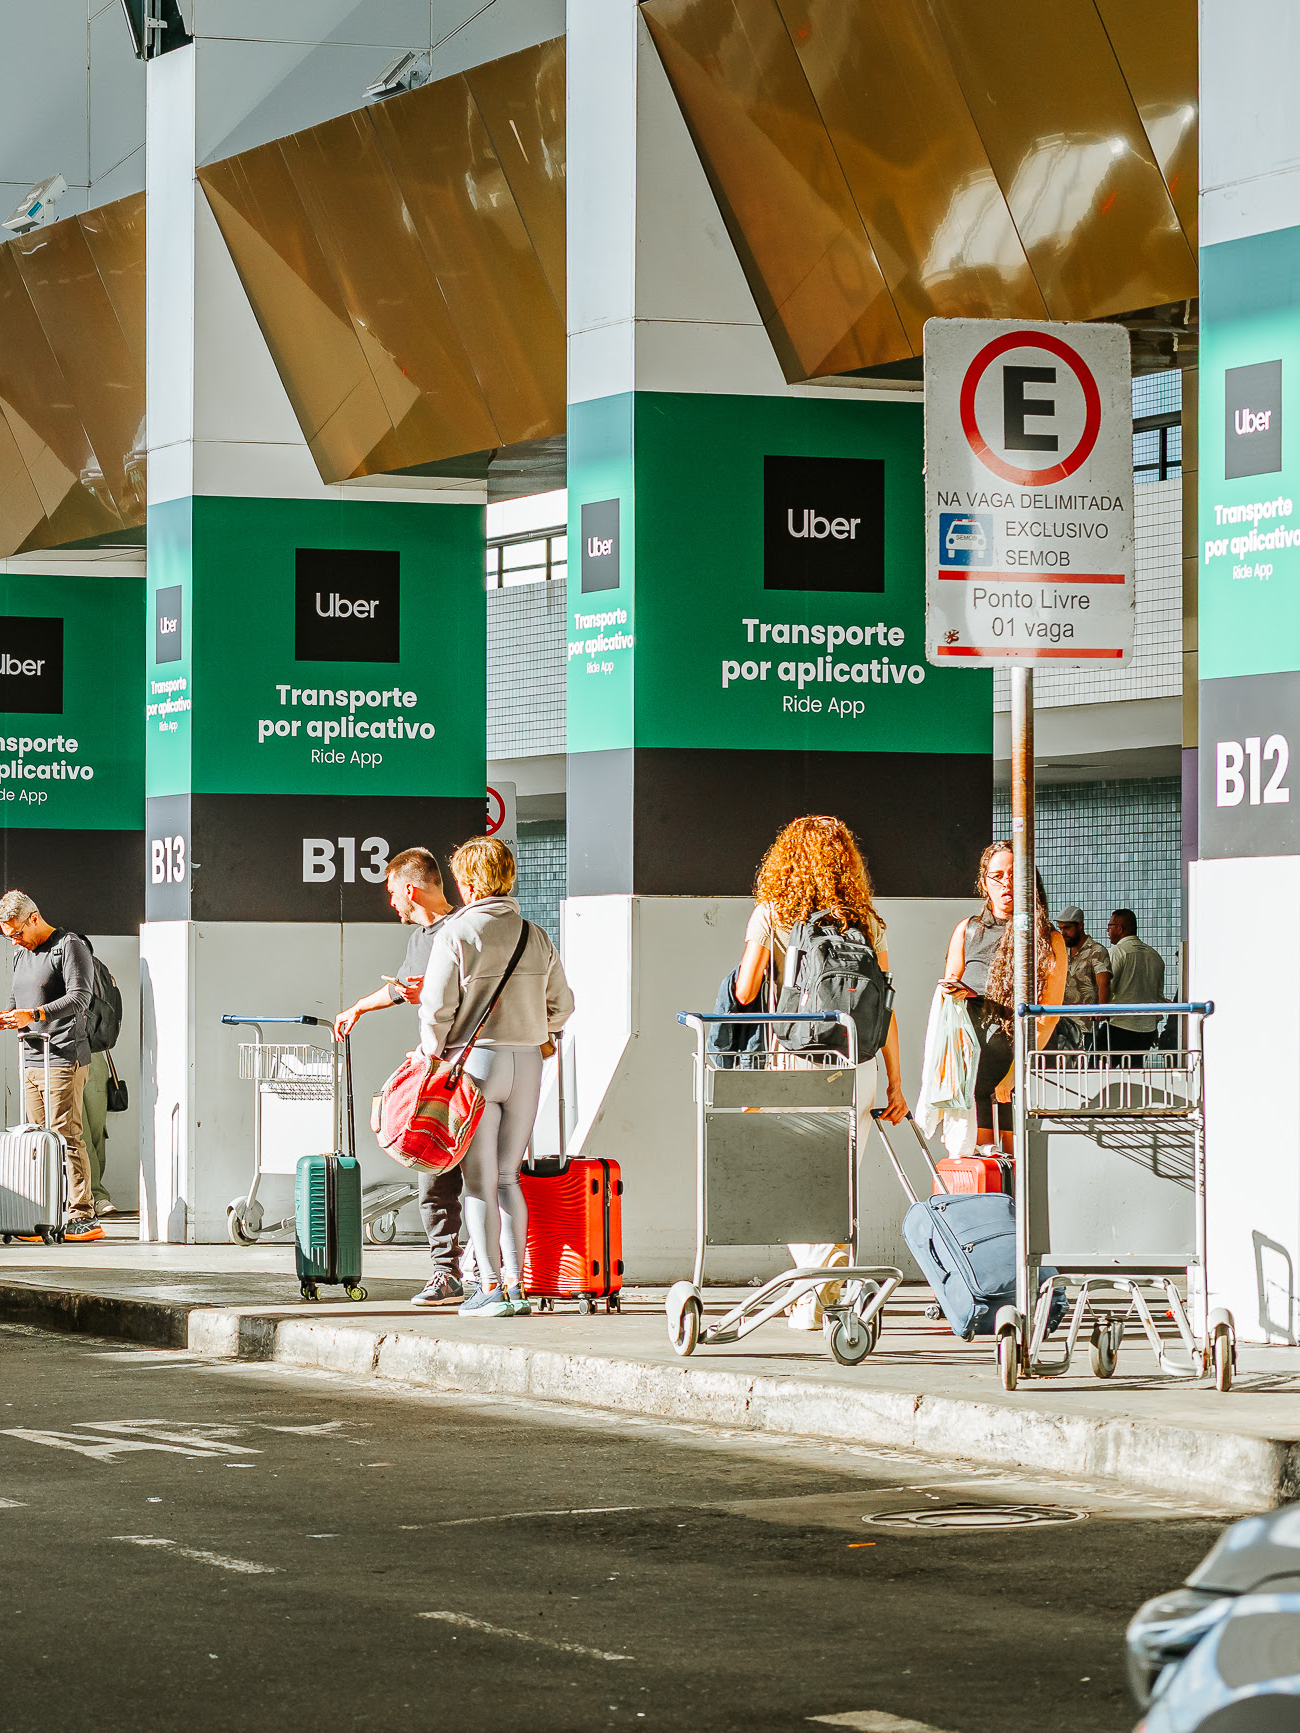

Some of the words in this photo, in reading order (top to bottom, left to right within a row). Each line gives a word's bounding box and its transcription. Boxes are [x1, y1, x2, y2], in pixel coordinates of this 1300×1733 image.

[1003, 365, 1059, 452] E
[1234, 408, 1272, 435] Uber
[937, 491, 961, 507] NA
[966, 492, 1015, 509] VAGA
[1021, 494, 1124, 512] DELIMITADA
[1214, 496, 1293, 527] Transporte
[787, 509, 861, 540] Uber
[1005, 521, 1109, 539] EXCLUSIVO
[587, 536, 613, 557] Uber
[1005, 549, 1071, 567] SEMOB
[1204, 538, 1229, 565] por
[1233, 564, 1252, 580] Ride
[1254, 563, 1273, 581] App
[316, 593, 379, 618] Uber
[973, 587, 1033, 610] Ponto
[1040, 589, 1090, 610] Livre
[160, 616, 178, 634] Uber
[574, 608, 627, 632] Transporte
[991, 618, 1015, 637] 01
[1025, 622, 1075, 643] vaga
[567, 640, 584, 661] por
[585, 631, 634, 658] aplicativo
[741, 619, 905, 653] Transporte
[586, 661, 600, 674] Ride
[601, 660, 614, 675] App
[721, 658, 773, 688] por
[777, 655, 926, 690] aplicativo
[151, 677, 187, 696] Transporte
[276, 684, 418, 713] Transporte
[146, 703, 158, 720] por
[158, 696, 192, 719] aplicativo
[783, 696, 822, 714] Ride
[827, 697, 865, 718] App
[258, 718, 301, 743] por
[306, 716, 436, 744] aplicativo
[311, 749, 345, 764] Ride
[350, 750, 383, 766] App
[1216, 733, 1290, 807] B12
[19, 789, 48, 805] App
[151, 835, 186, 884] B13
[302, 837, 390, 883] B13
